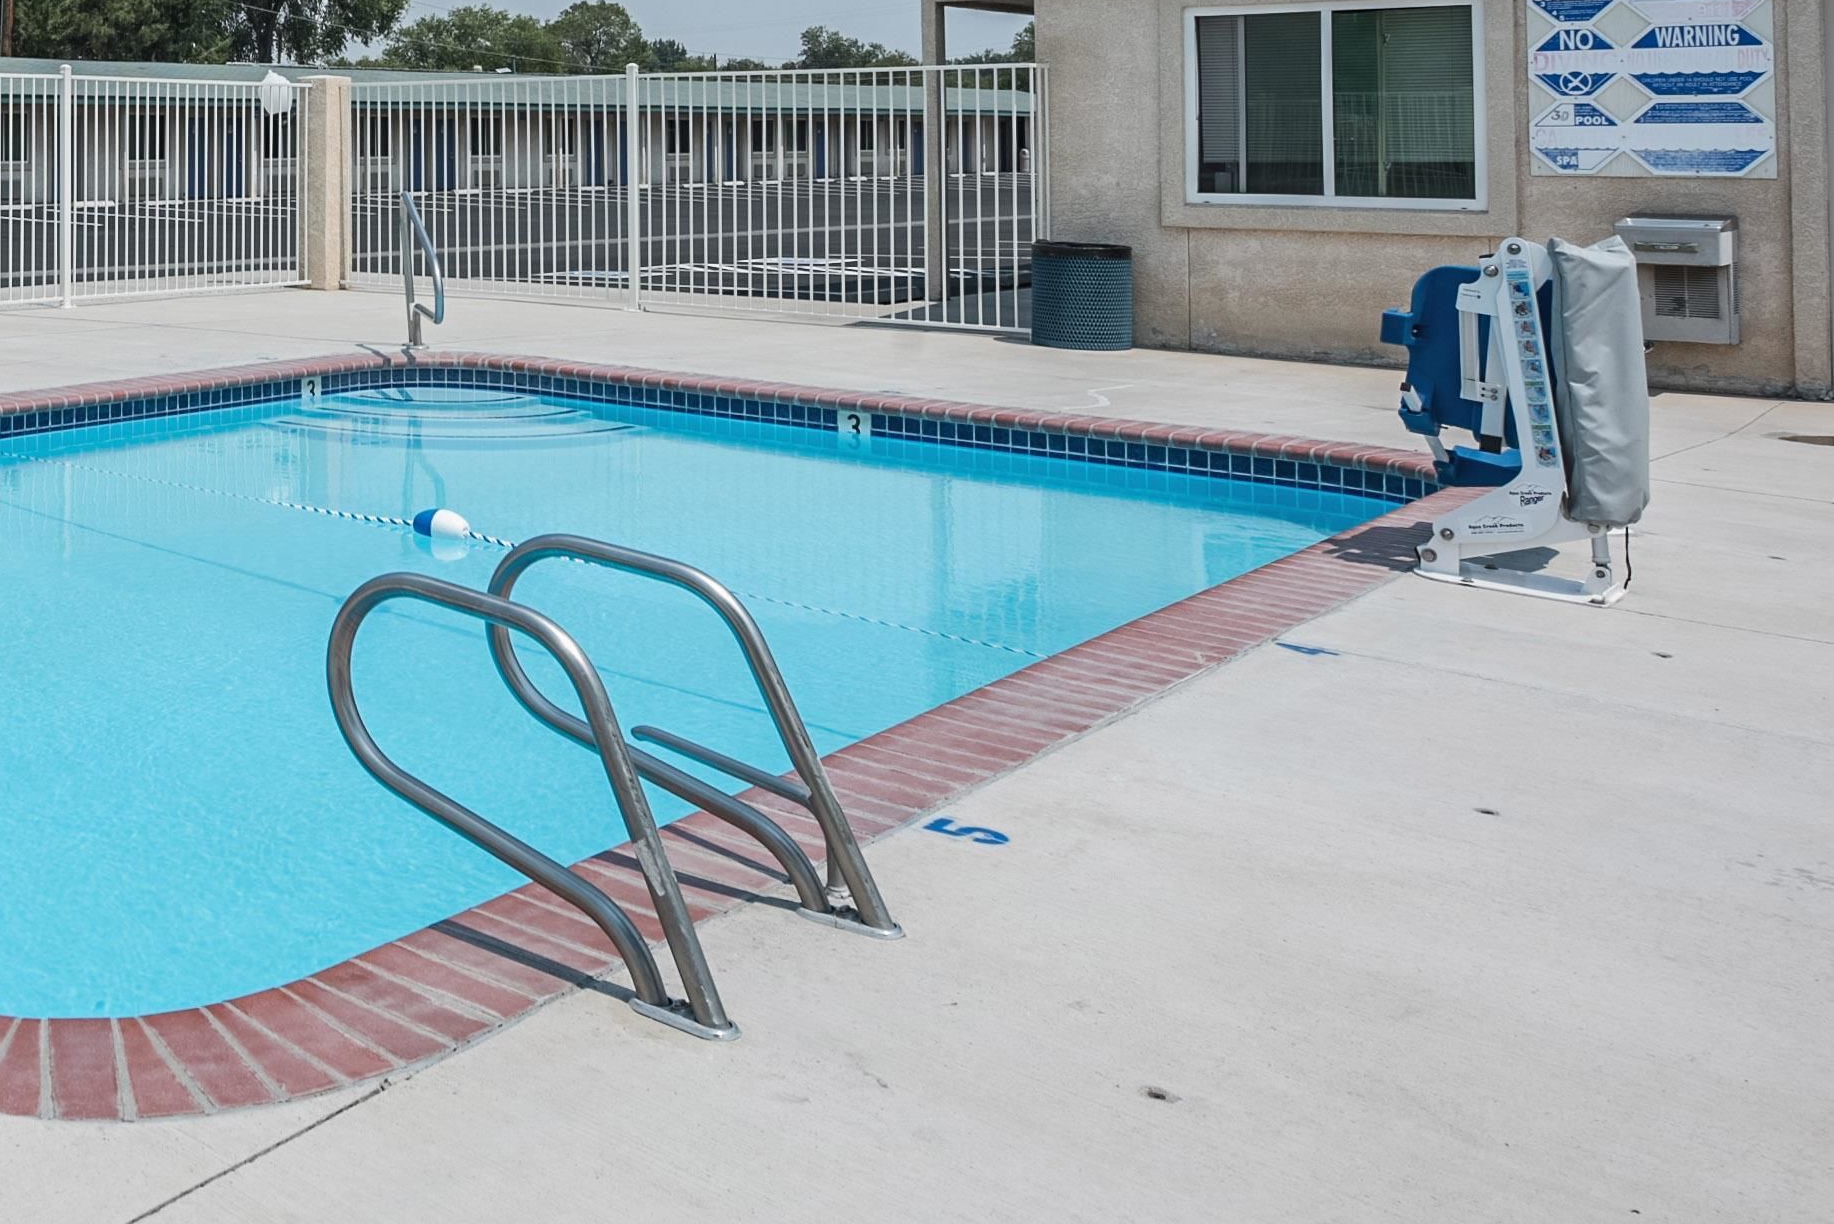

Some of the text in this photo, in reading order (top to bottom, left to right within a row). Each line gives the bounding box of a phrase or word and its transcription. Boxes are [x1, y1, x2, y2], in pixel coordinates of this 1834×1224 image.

[1559, 29, 1594, 51] NO
[1654, 24, 1740, 47] WARNING
[1575, 116, 1609, 125] POOL
[1557, 155, 1578, 166] SPA
[1520, 495, 1544, 507] Ranger
[922, 818, 1010, 845] 5
